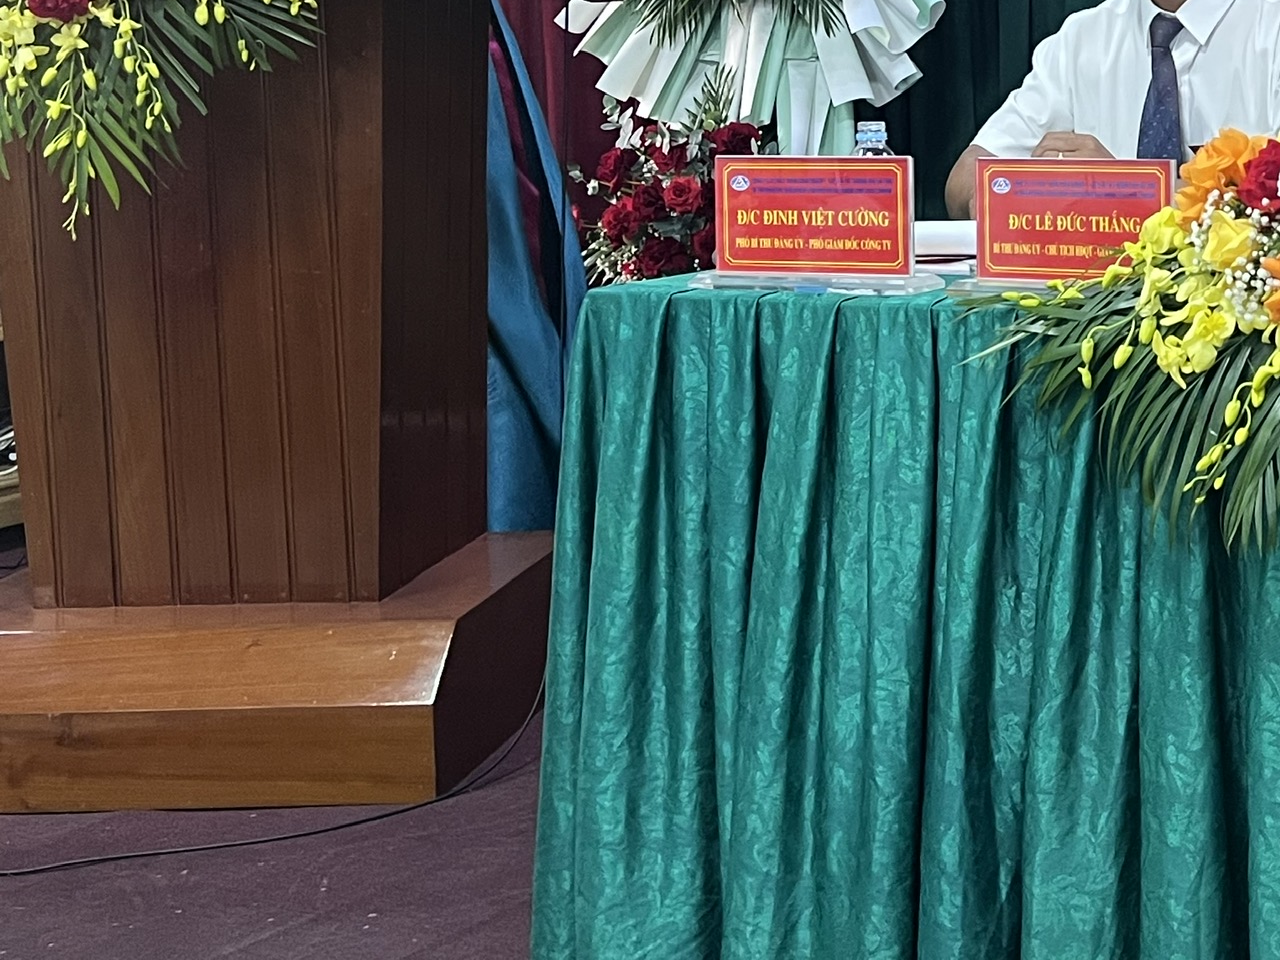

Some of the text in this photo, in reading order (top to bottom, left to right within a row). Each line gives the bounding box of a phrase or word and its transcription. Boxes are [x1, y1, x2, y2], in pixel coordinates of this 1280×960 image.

[737, 206, 889, 229] Đ/C ĐINH VIỆT CƯỜNG
[1008, 210, 1140, 233] Đ/C LÊ ĐỨC THẮNG
